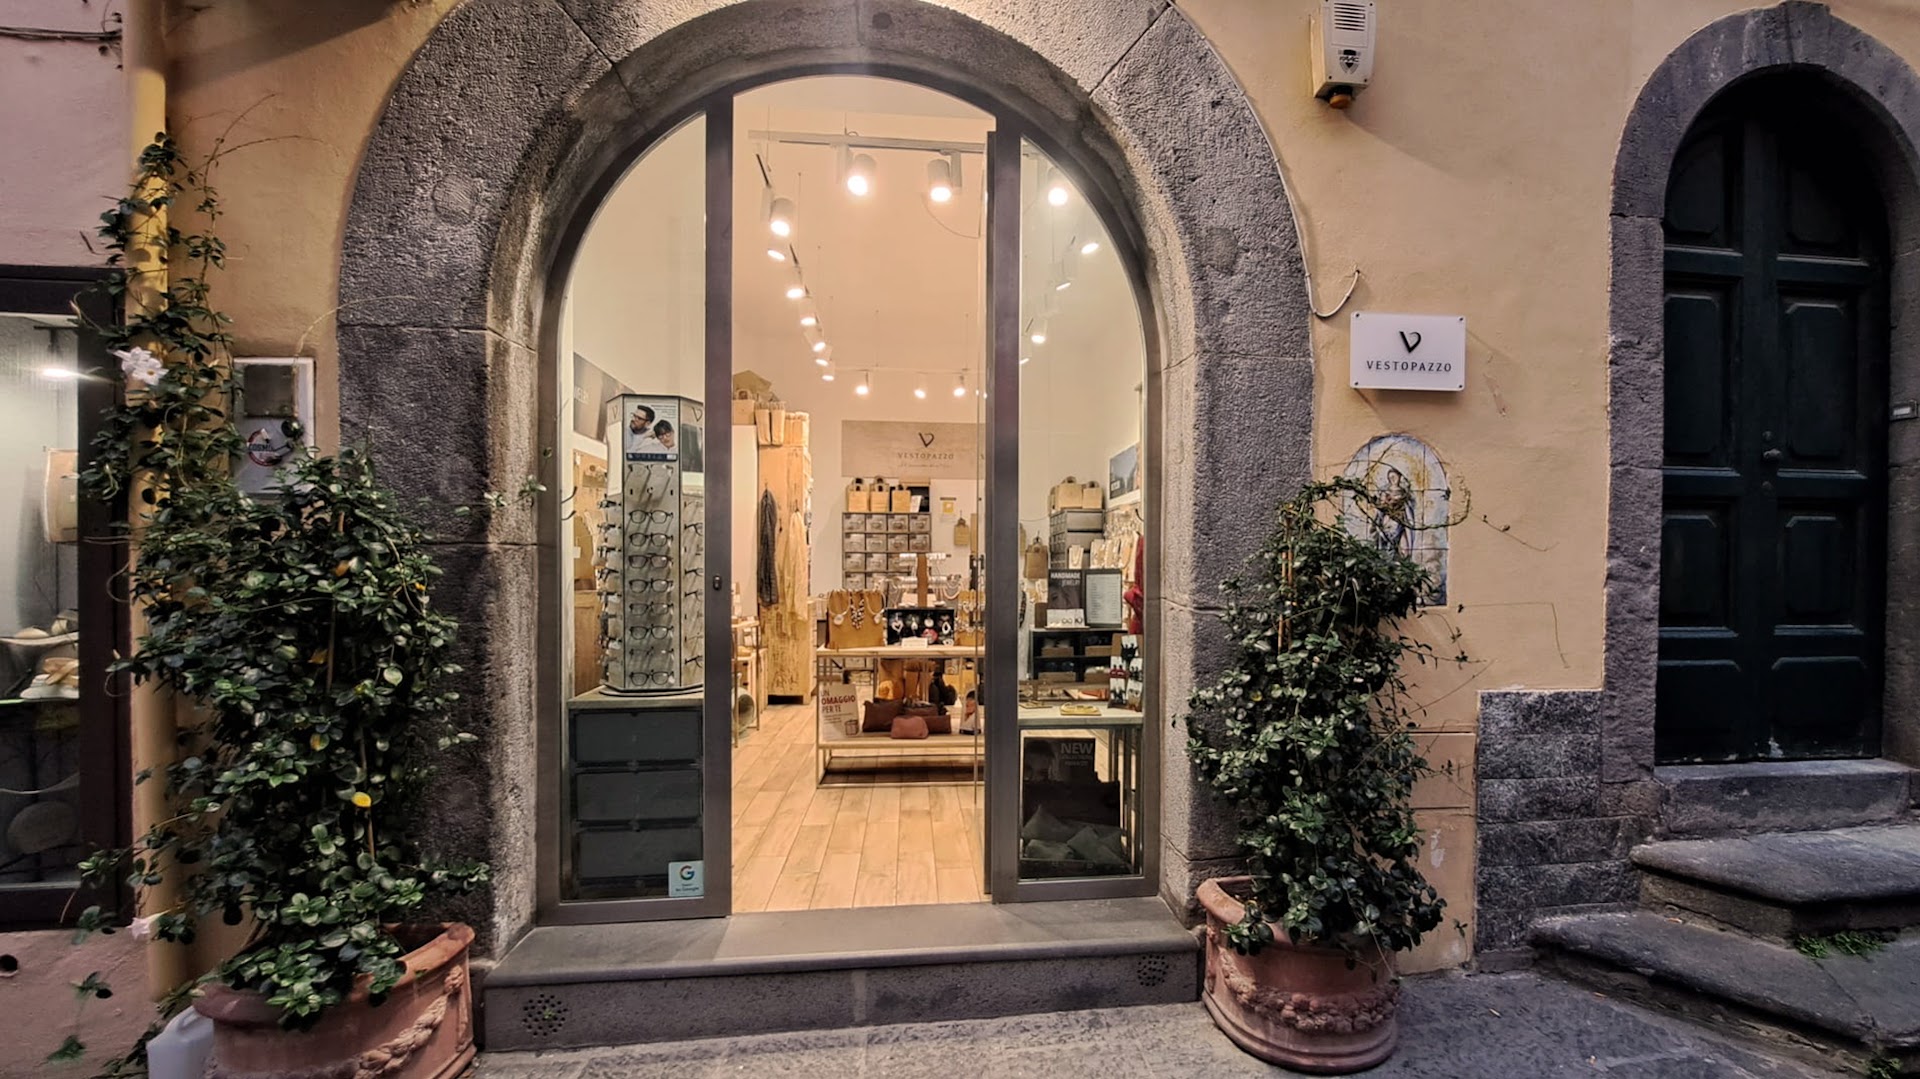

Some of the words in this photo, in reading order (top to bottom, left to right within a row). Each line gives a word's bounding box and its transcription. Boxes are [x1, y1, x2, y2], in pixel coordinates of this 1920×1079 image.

[1366, 360, 1452, 373] VESTOPAZZO
[897, 452, 954, 460] VESTOPAZZO
[821, 689, 830, 697] UN
[821, 694, 856, 705] OMAGGIO
[822, 705, 834, 713] PER
[834, 704, 841, 712] TE
[1060, 742, 1094, 755] NEW
